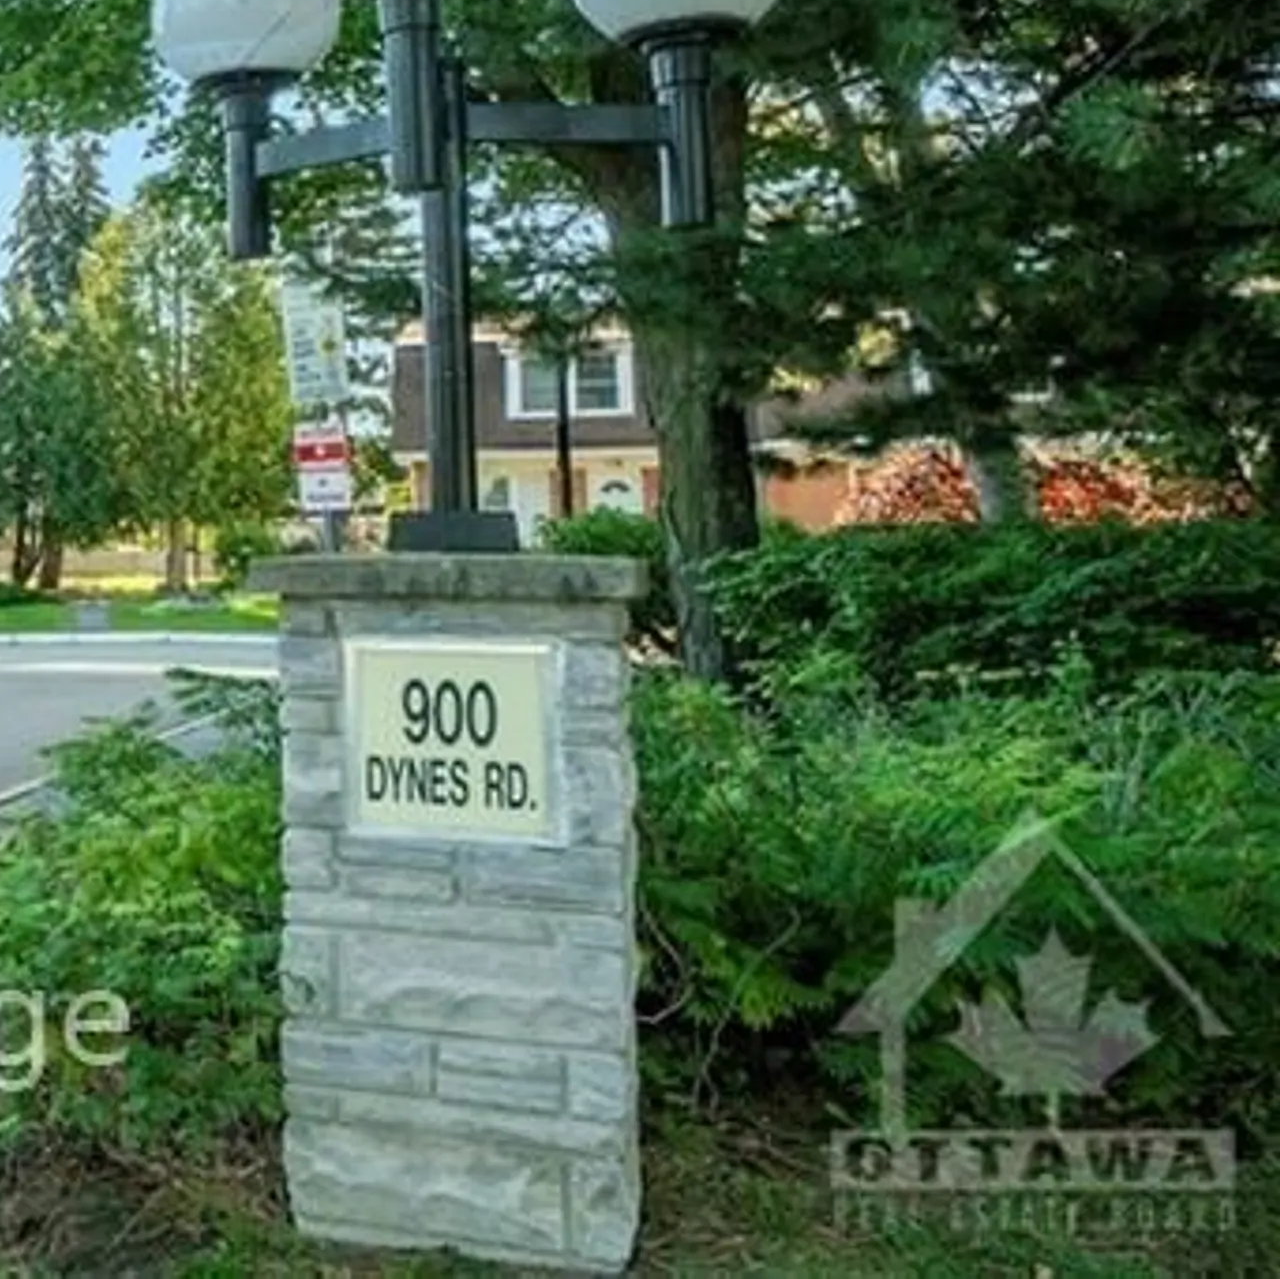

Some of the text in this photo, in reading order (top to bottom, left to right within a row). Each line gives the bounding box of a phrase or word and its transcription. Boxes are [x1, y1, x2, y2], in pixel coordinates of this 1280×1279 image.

[402, 678, 498, 747] 900
[366, 754, 538, 811] DYNES RD.
